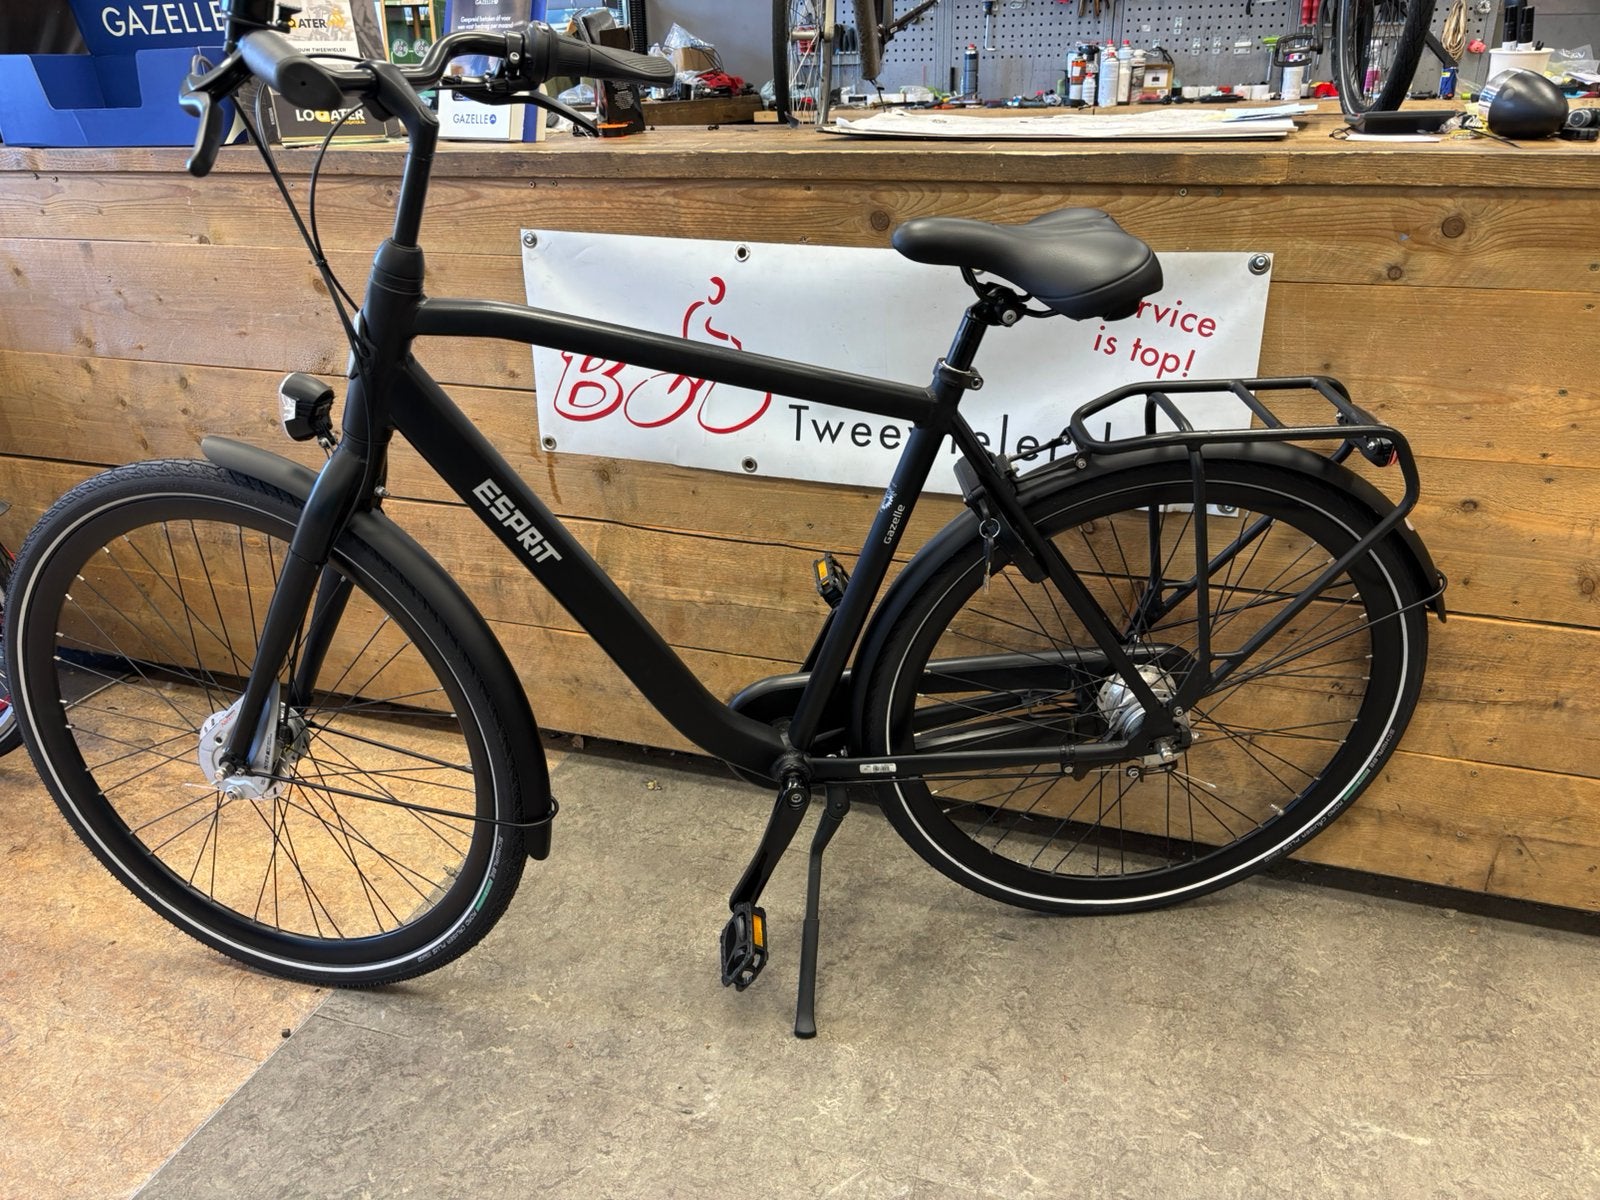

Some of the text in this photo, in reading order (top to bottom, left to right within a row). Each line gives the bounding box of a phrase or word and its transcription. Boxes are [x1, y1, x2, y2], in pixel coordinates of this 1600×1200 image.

[101, 1, 225, 37] GAZELLE
[453, 113, 489, 125] GAZELLE
[1136, 300, 1216, 337] rvice
[1094, 325, 1195, 379] is top!
[472, 478, 562, 563] ESPRIT
[883, 504, 906, 545] Gazelle
